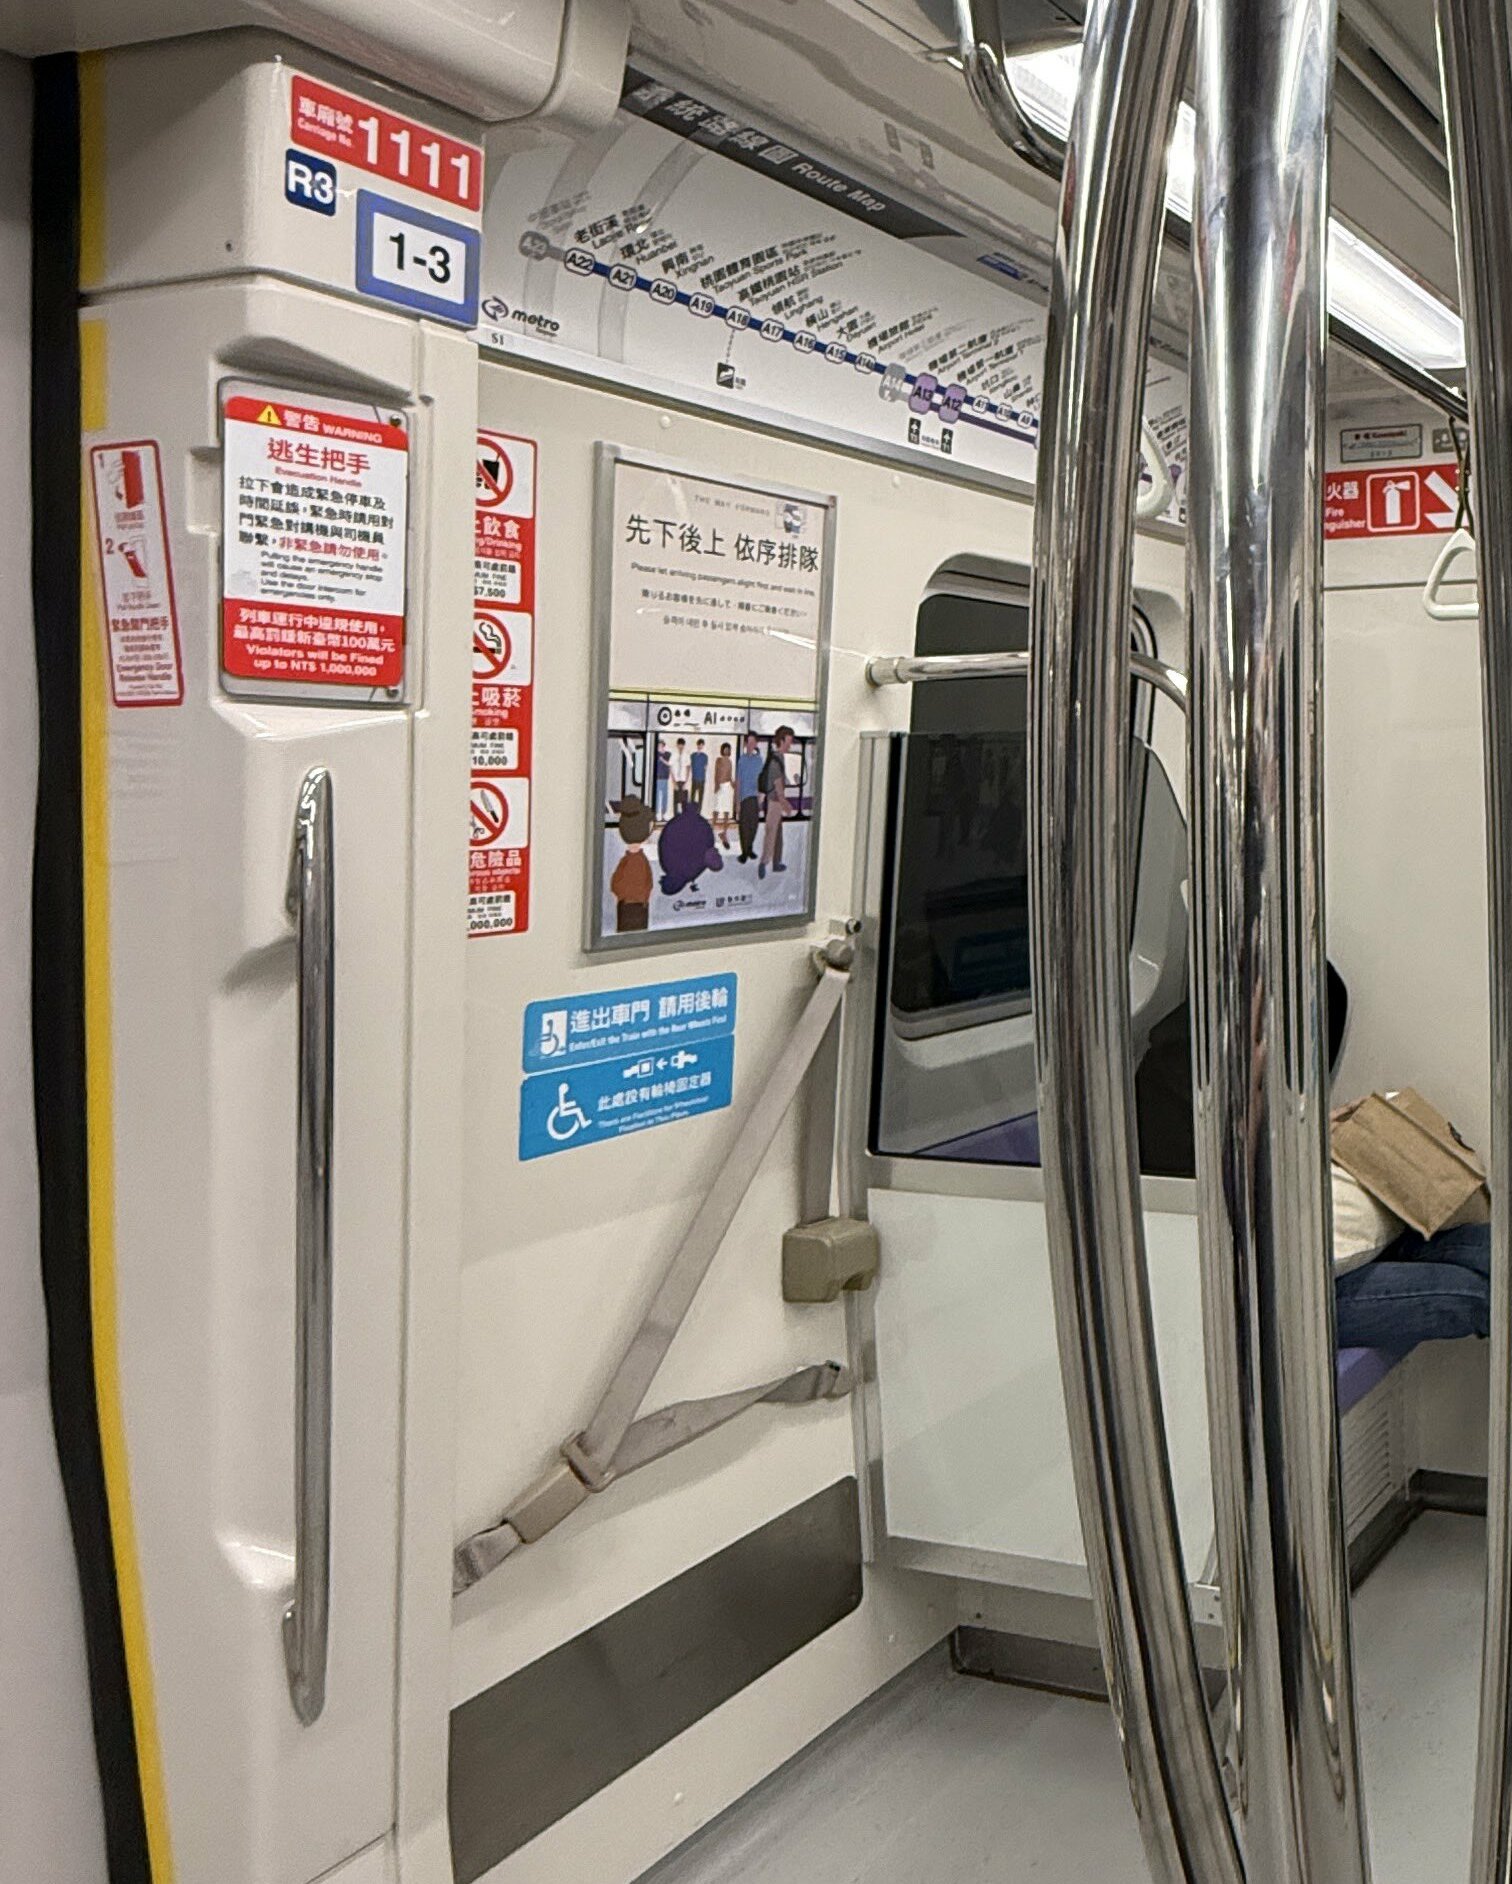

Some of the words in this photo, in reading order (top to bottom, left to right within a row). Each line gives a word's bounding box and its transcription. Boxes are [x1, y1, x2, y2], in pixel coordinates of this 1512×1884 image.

[358, 117, 470, 199] 1111
[287, 161, 334, 205] R3
[792, 162, 848, 193] Route
[848, 188, 886, 213] Map
[389, 233, 451, 284] 1-3
[566, 253, 593, 272] A22
[612, 268, 635, 287] A21
[652, 283, 675, 300] A20
[689, 297, 713, 314] A19
[512, 309, 560, 332] metro
[762, 322, 782, 338] A17
[795, 335, 814, 350] A16
[827, 344, 846, 360] A15
[914, 384, 934, 402] A13
[942, 397, 962, 412] A12
[283, 410, 320, 432] 警告
[323, 423, 383, 444] WARNING
[267, 438, 371, 475] 逃生把手
[1327, 481, 1359, 501] 火器
[105, 537, 115, 555] 2
[625, 513, 726, 557] 先下後上
[734, 532, 820, 573] 依序排隊
[246, 644, 304, 658] Violators
[307, 649, 328, 660] will
[331, 651, 347, 661] be
[350, 652, 384, 665] Fined
[253, 659, 271, 670] up
[274, 659, 288, 669] to
[570, 999, 651, 1034] 進出車門
[658, 987, 729, 1019] 請用後輪
